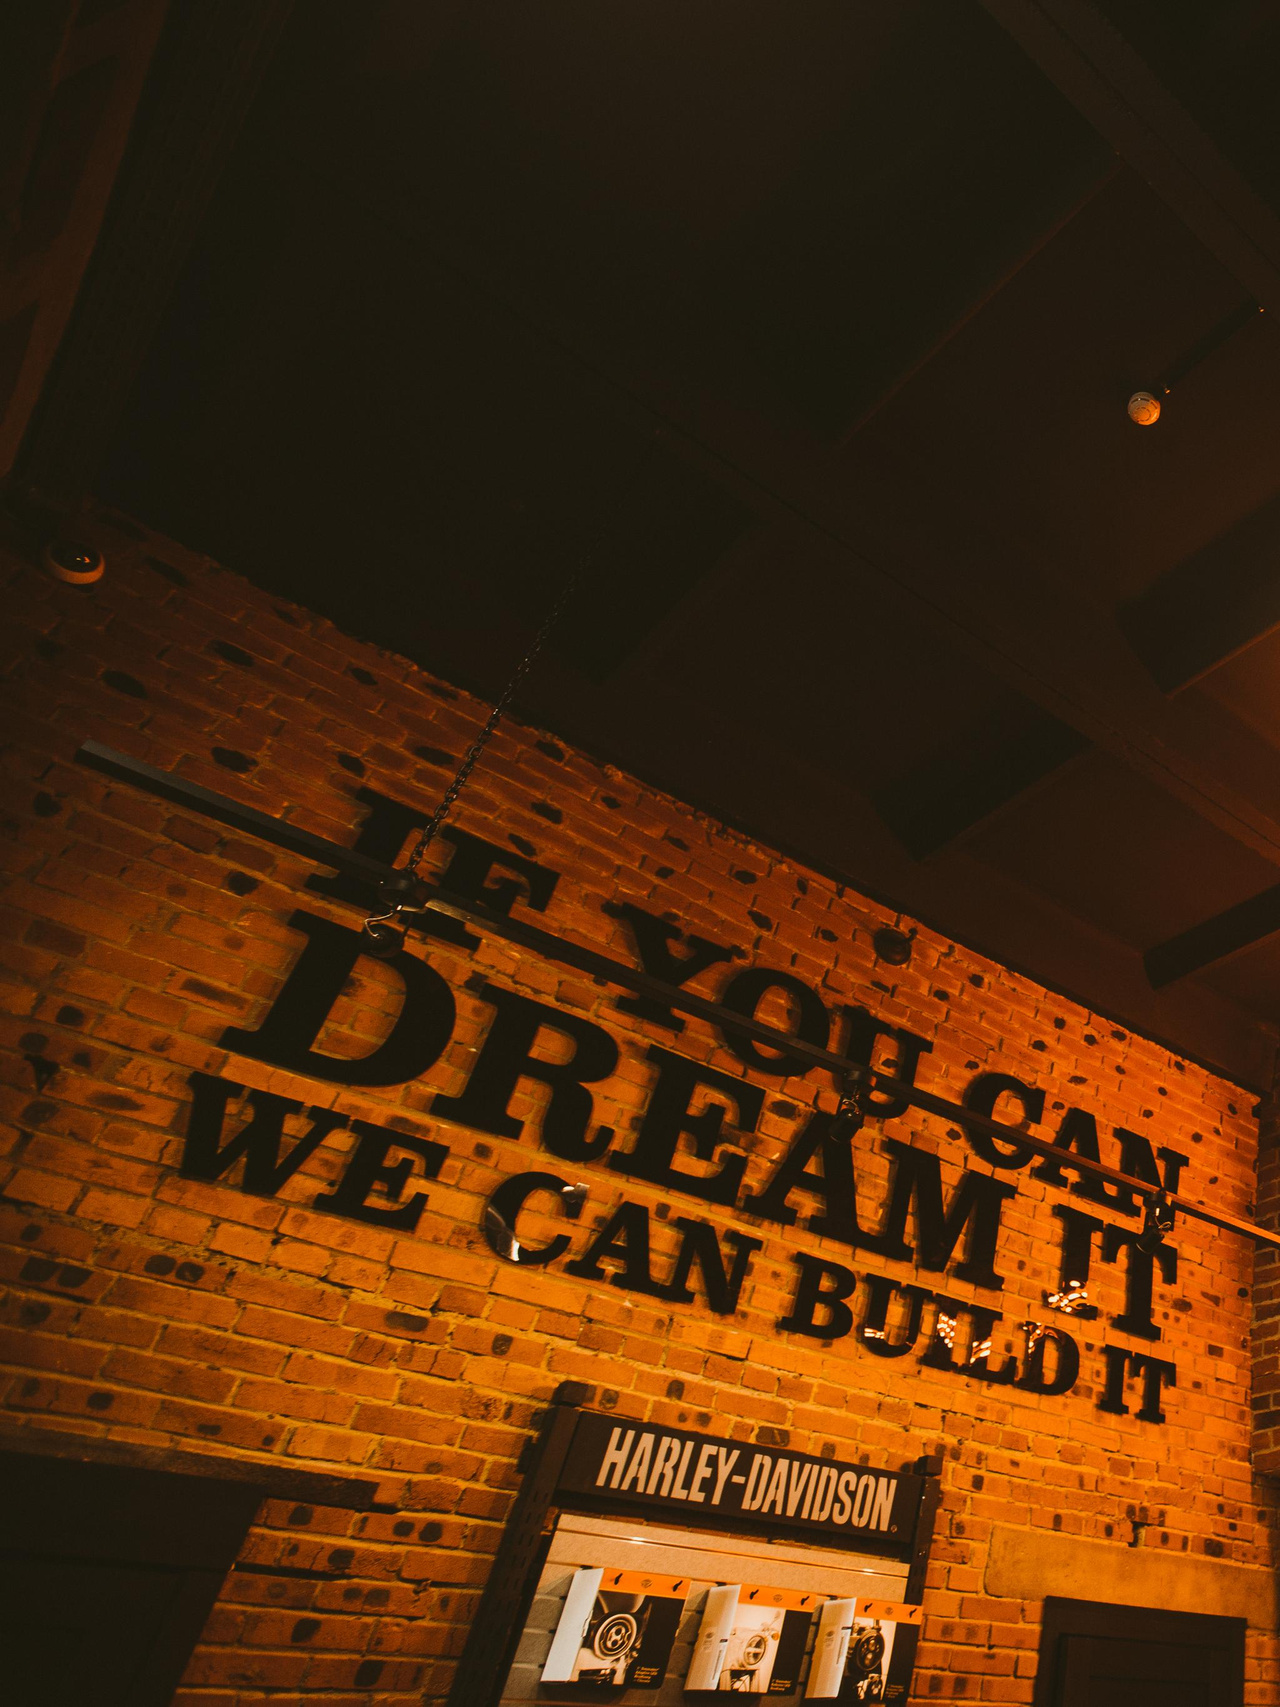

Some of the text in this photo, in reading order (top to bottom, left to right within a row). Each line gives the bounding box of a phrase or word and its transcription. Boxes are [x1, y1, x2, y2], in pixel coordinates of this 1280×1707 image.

[218, 908, 1178, 1341] DREAM IT
[305, 787, 1190, 1217] IF YOU CAN
[178, 1070, 1177, 1424] WE CAN BUILD IT
[595, 1427, 898, 1532] HARLEY-DAVIDSON
